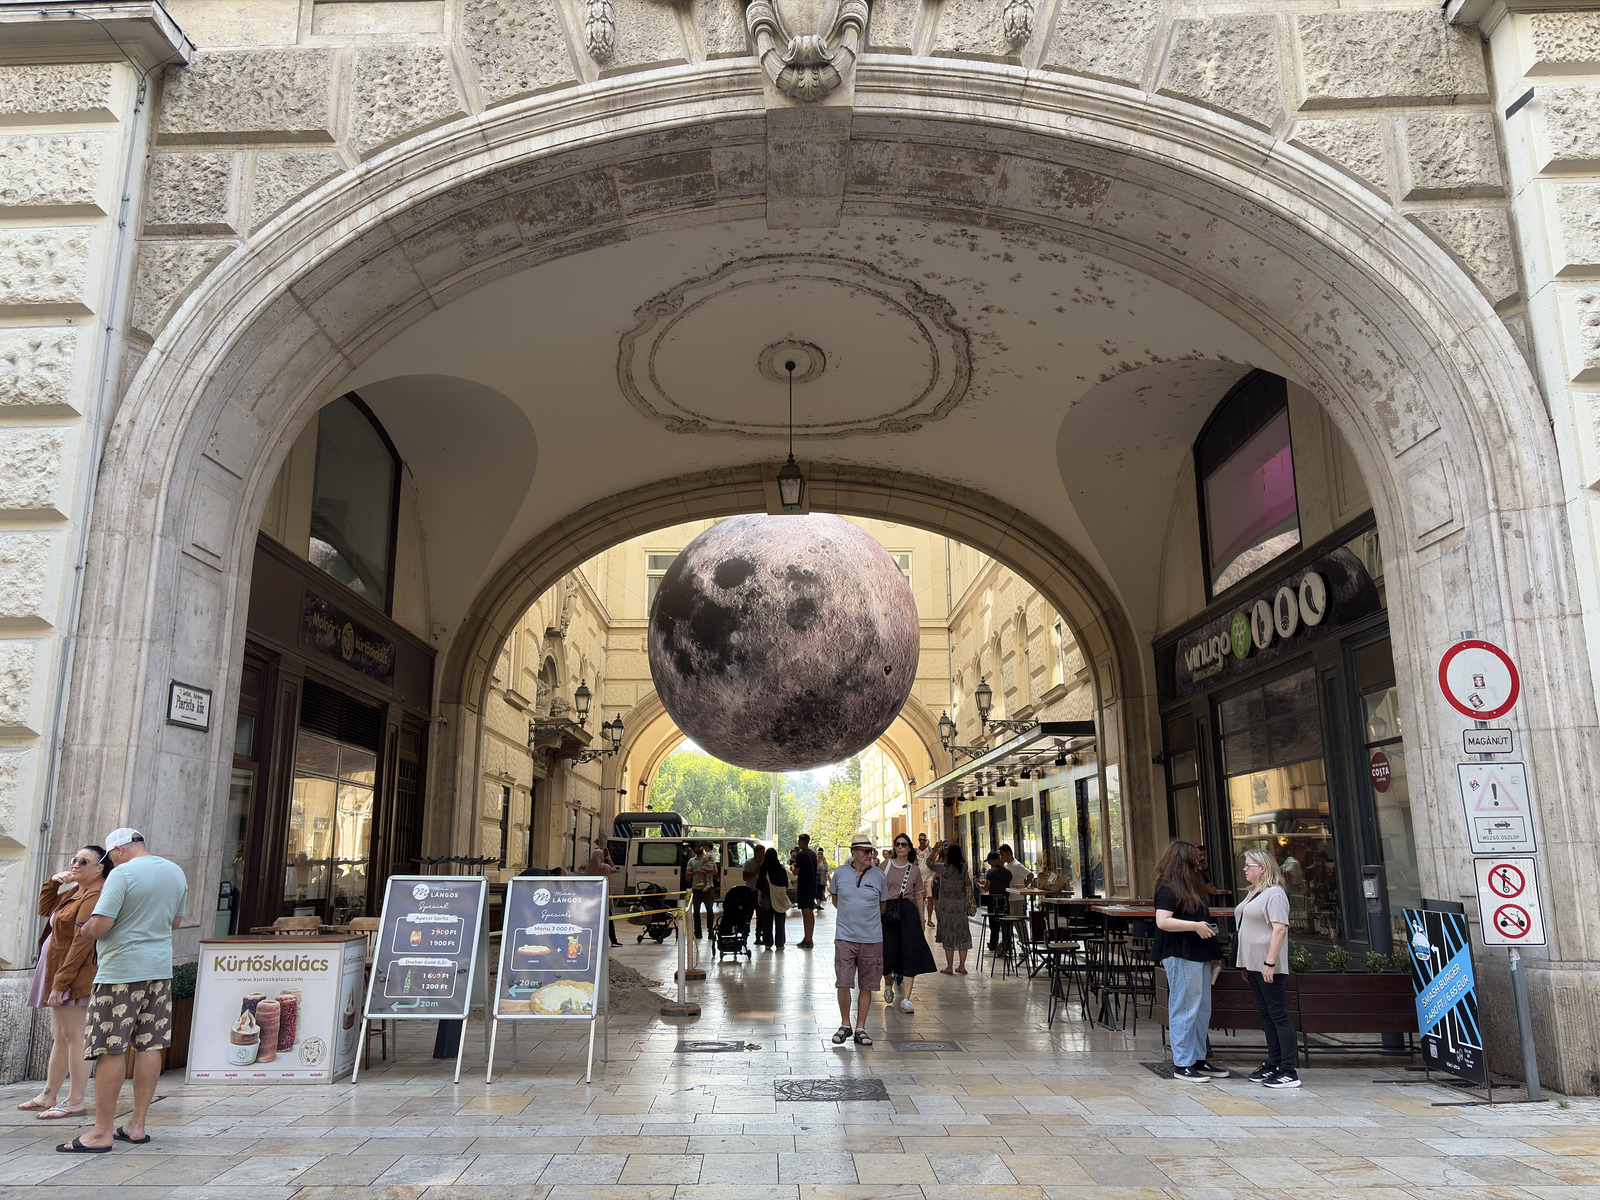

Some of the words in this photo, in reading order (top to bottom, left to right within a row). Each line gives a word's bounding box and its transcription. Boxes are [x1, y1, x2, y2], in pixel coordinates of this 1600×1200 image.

[312, 611, 341, 640] Molnár's
[1184, 631, 1231, 672] vinugo
[175, 694, 195, 712] Piarista
[1467, 736, 1509, 746] MAGÁNÚT
[1371, 766, 1390, 777] COSTA
[418, 901, 450, 912] Special
[213, 954, 329, 972] Kürtőskalács
[1421, 985, 1440, 1008] SMASH
[1438, 963, 1461, 993] BURGER
[1457, 974, 1470, 995] EUR
